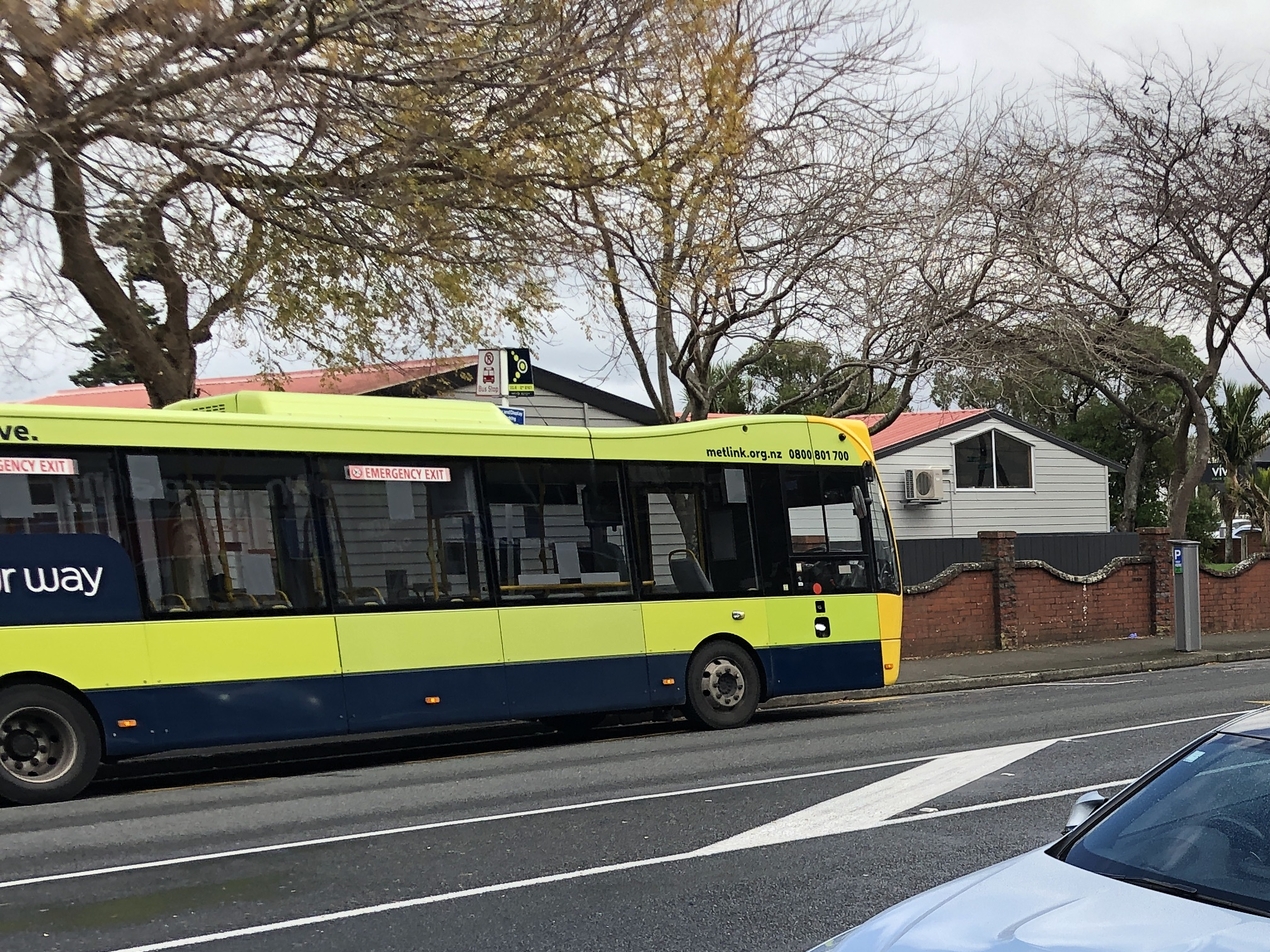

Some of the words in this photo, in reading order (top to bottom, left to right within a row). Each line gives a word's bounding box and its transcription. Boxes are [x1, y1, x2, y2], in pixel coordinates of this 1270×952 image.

[706, 446, 782, 461] metlink.org.nz
[789, 449, 812, 460] 0800
[815, 450, 831, 460] 801
[832, 450, 849, 461] 700
[40, 460, 66, 473] EXIT
[365, 467, 422, 479] EMERGENCY
[425, 469, 444, 480] EXIT
[1174, 549, 1182, 560] P
[23, 566, 104, 597] way
